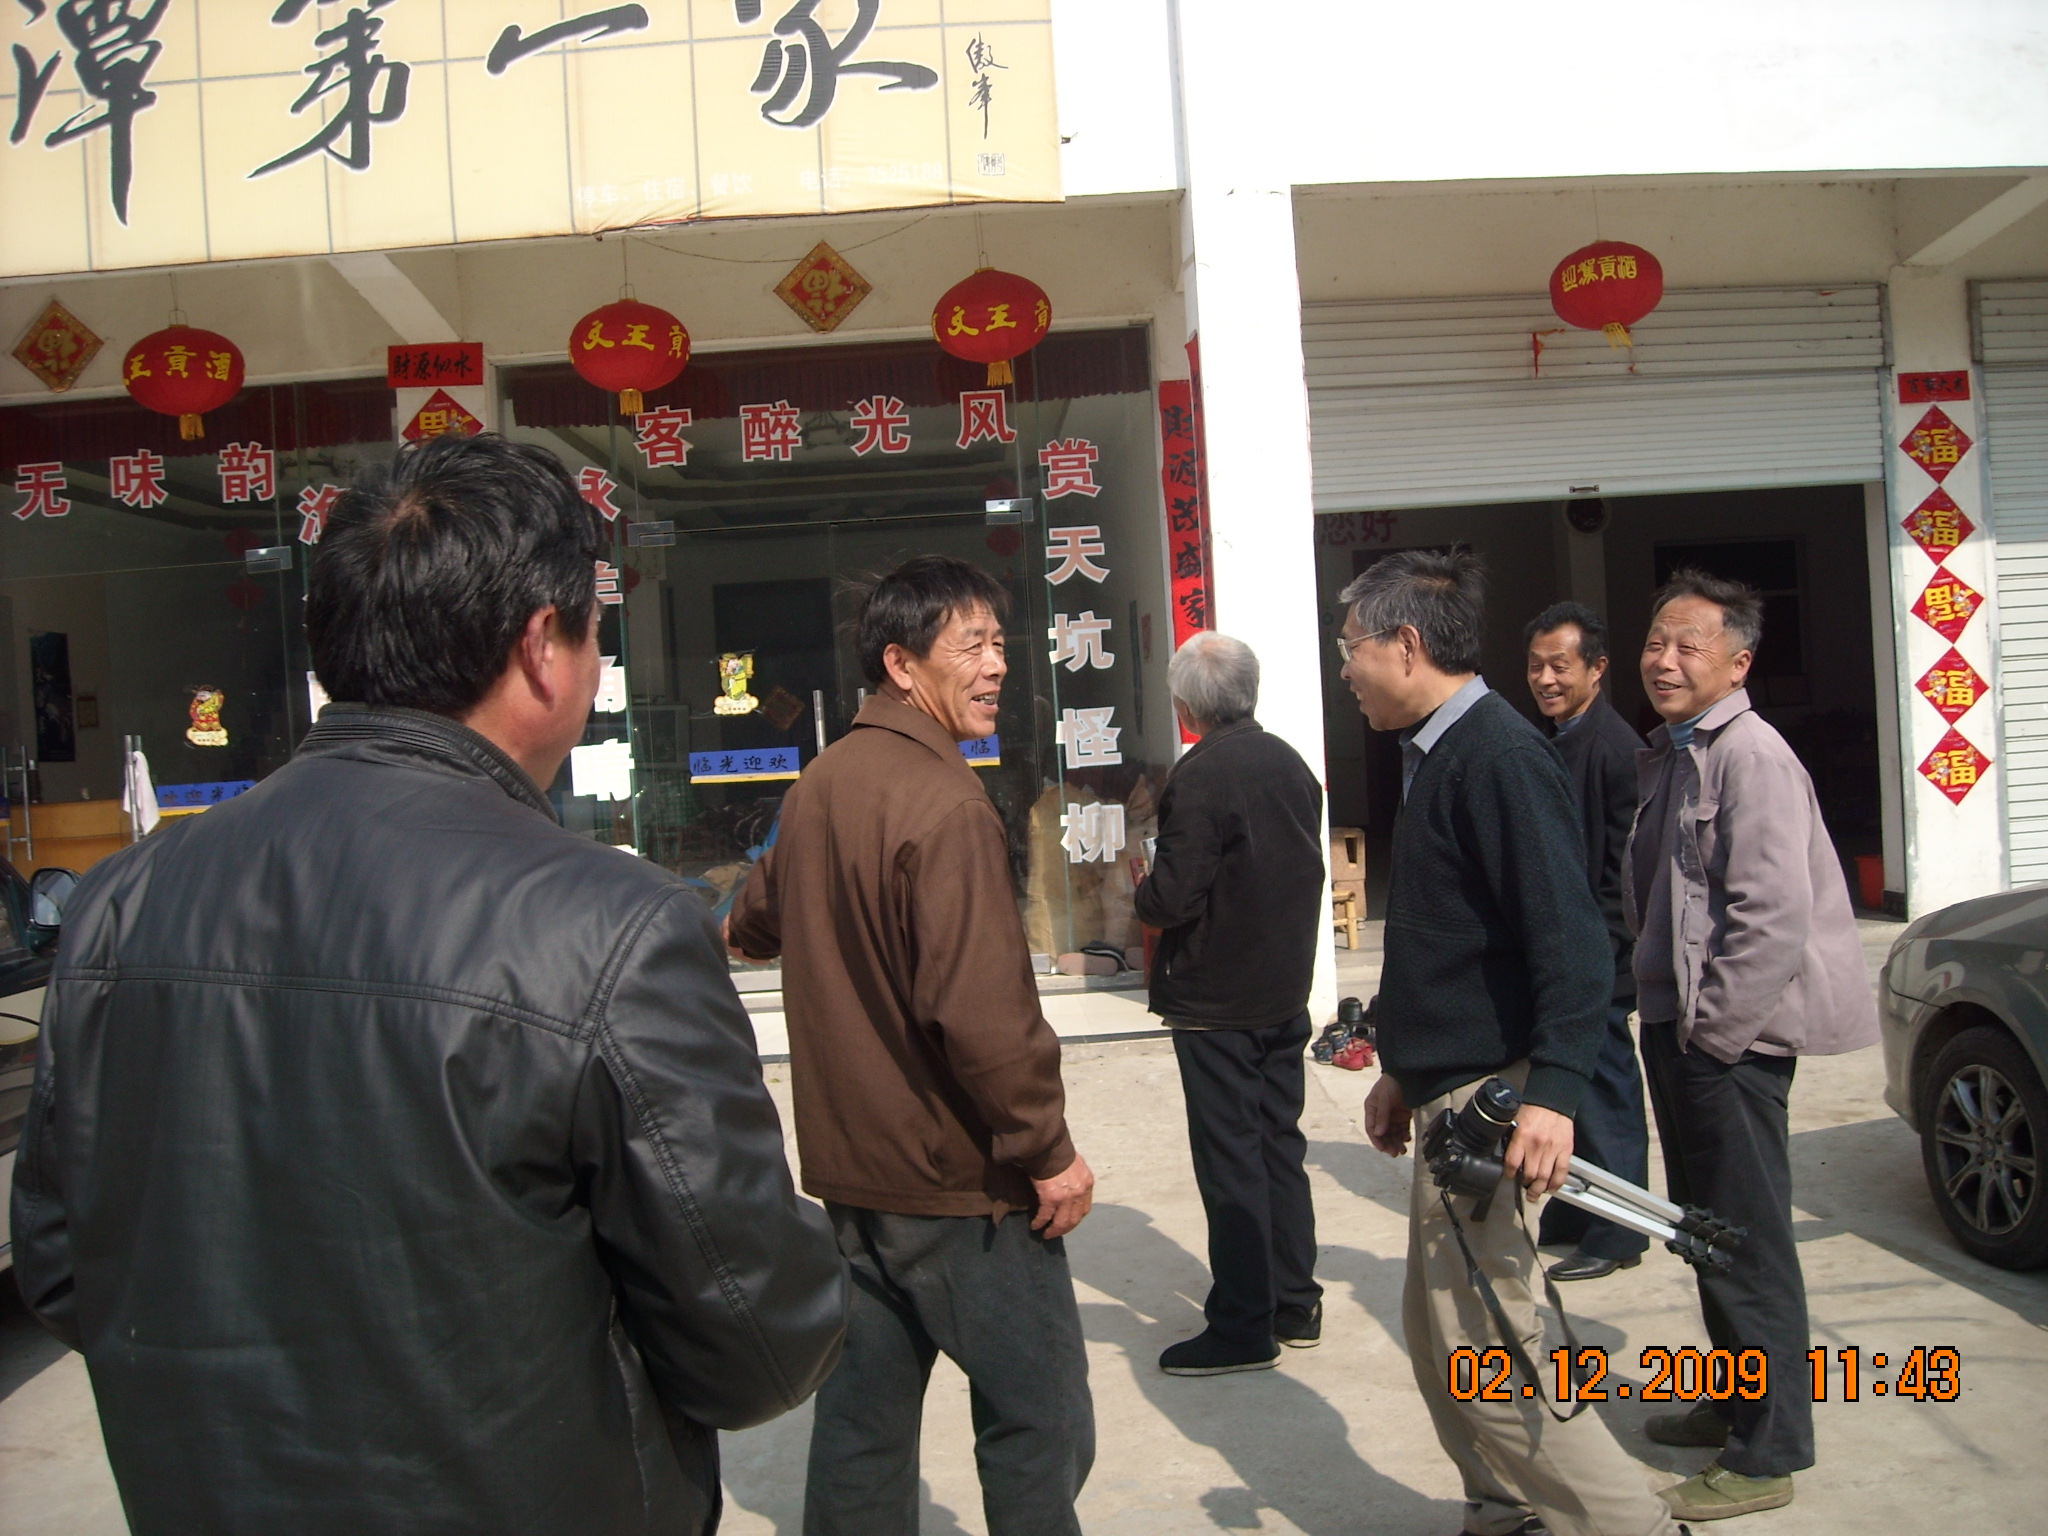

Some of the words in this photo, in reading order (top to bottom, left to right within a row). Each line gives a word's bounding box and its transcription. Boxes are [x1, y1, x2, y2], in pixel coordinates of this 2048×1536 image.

[1908, 424, 1960, 465] 福
[1910, 507, 1961, 547] 福
[1923, 583, 1976, 628] 福
[1037, 438, 1127, 864] 赏天坑怪柳
[1923, 667, 1975, 706] 福
[1926, 746, 1977, 786] 福
